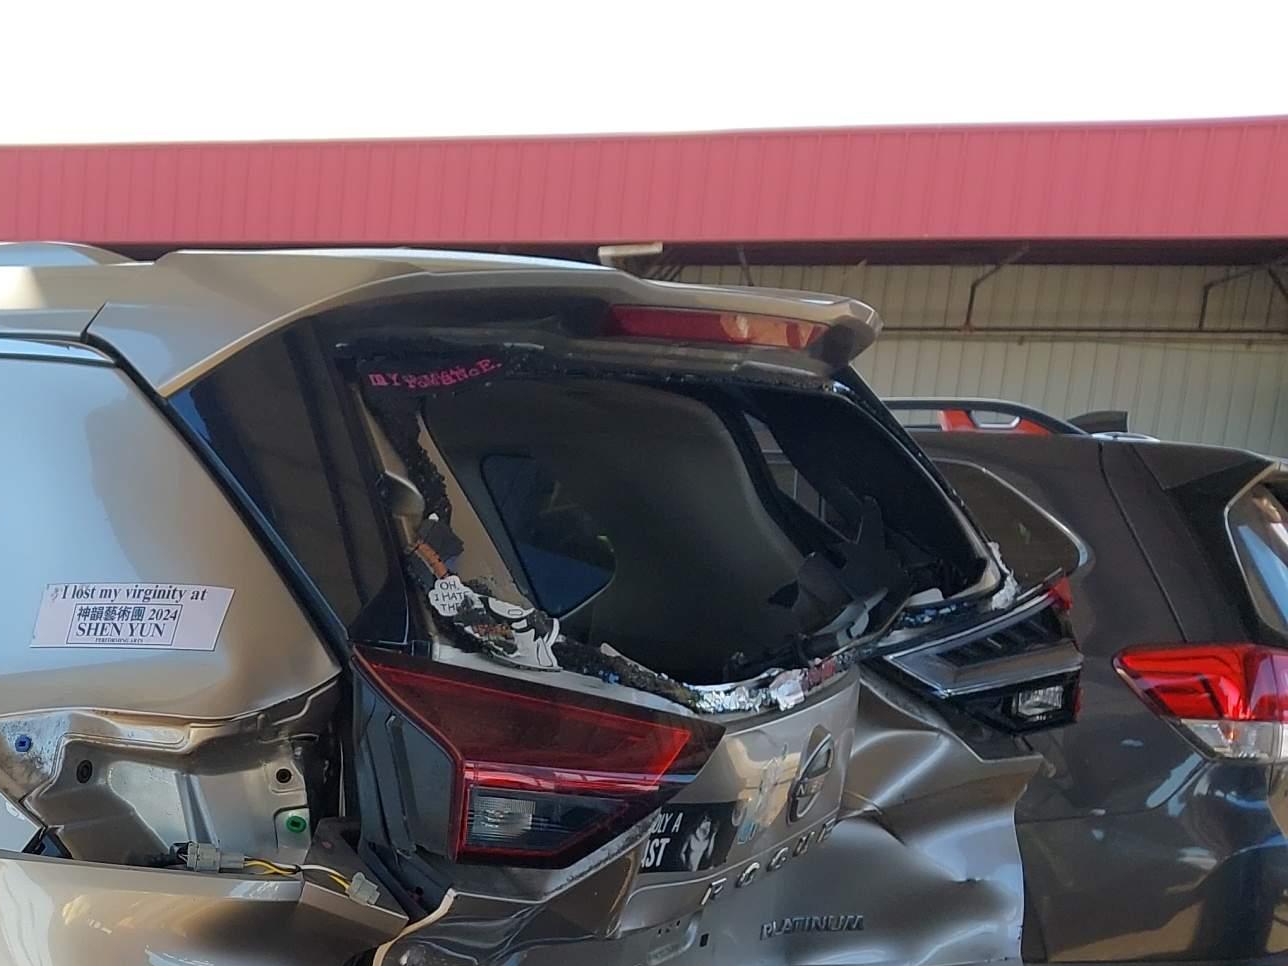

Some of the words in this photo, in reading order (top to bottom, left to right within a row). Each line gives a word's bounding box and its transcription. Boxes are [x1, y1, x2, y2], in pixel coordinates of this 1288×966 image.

[62, 585, 69, 599] I
[71, 585, 96, 599] lost
[99, 588, 122, 602] my
[125, 585, 187, 603] virginity
[190, 588, 209, 601] at
[434, 593, 440, 602] I
[77, 606, 147, 622] 神韻藝術團
[148, 608, 178, 621] 2024
[75, 622, 124, 637] SHEN
[128, 622, 166, 637] YUN
[671, 812, 683, 833] A
[760, 915, 864, 940] PLATINUM
